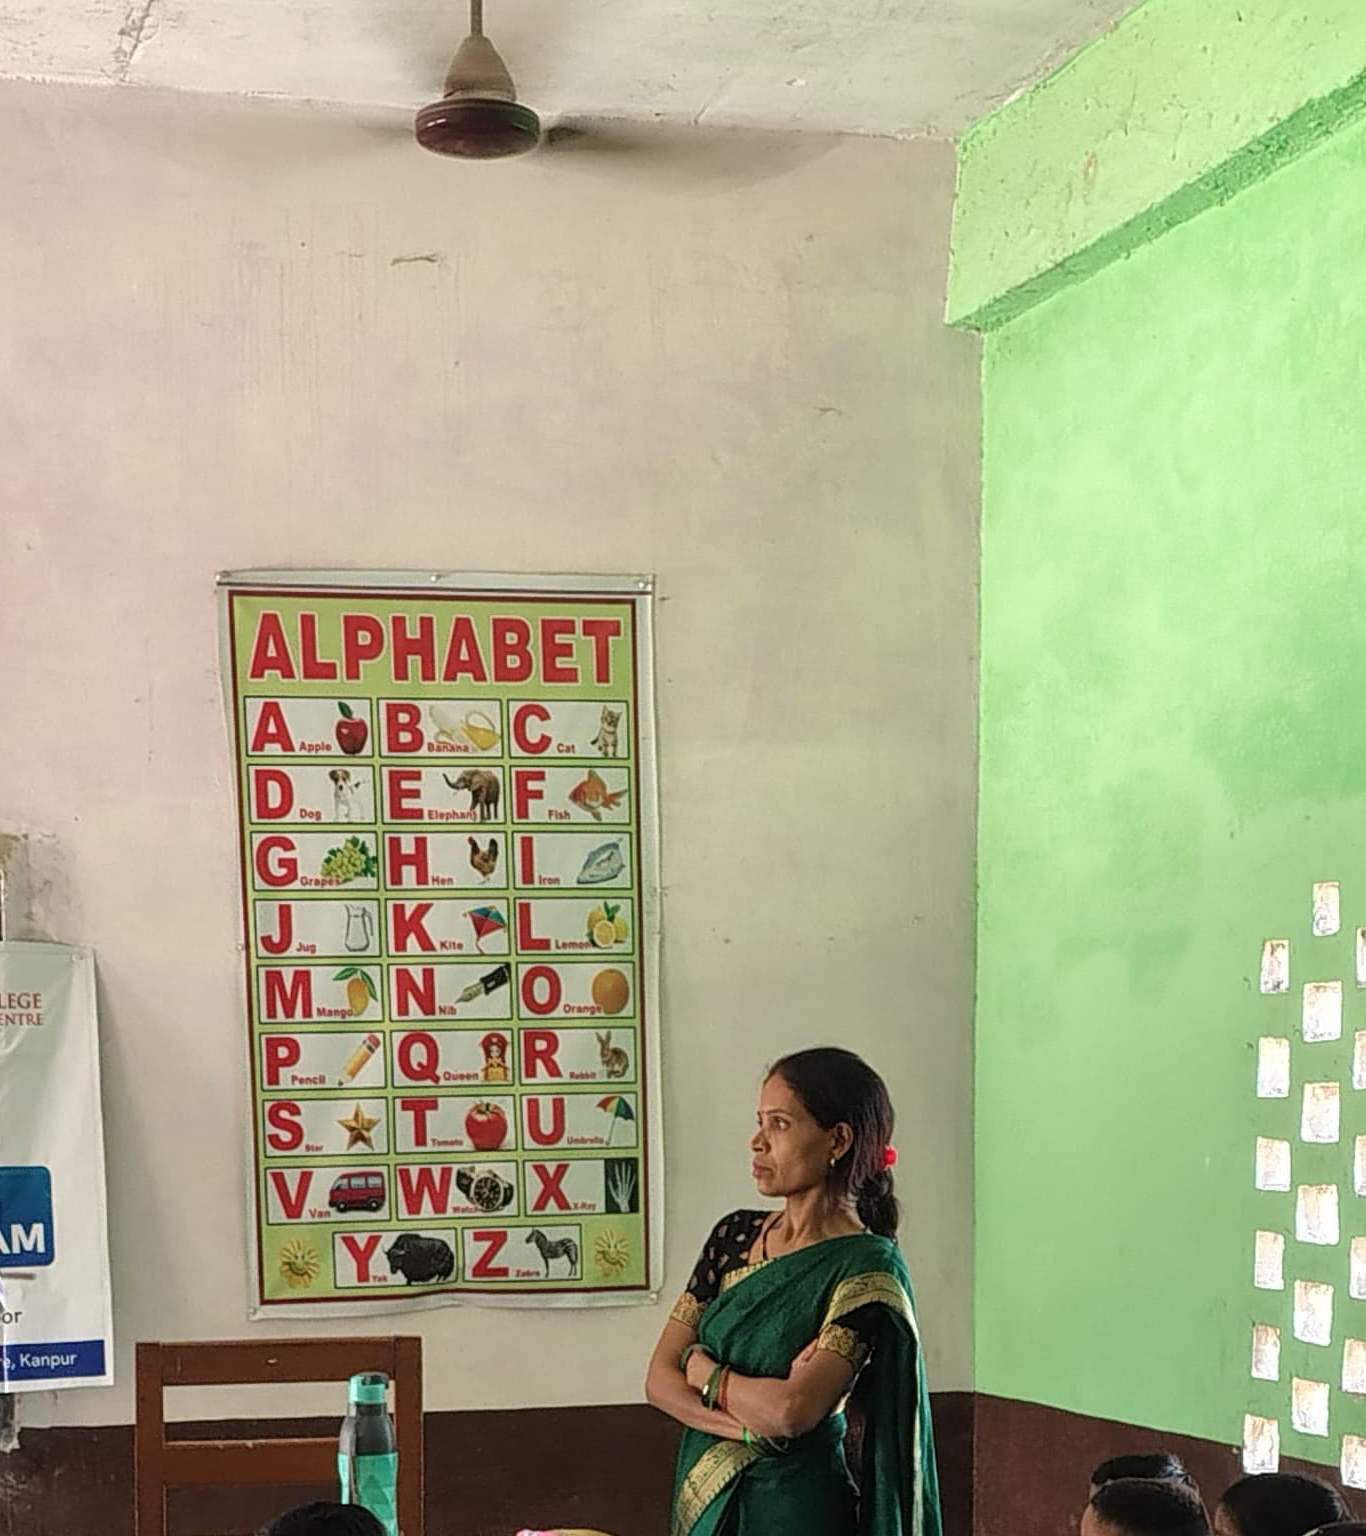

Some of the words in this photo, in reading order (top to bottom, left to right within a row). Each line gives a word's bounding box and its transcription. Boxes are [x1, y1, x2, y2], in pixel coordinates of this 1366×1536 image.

[248, 611, 621, 683] ALPHABET
[250, 701, 295, 753] A
[299, 742, 332, 753] Apple
[385, 703, 424, 753] B
[426, 742, 470, 754] Banana
[513, 703, 552, 754] C
[556, 743, 576, 754] Cat
[254, 769, 293, 820] D
[298, 808, 323, 822] Dog
[388, 770, 424, 819] E
[427, 809, 478, 823] Elephant
[515, 771, 545, 819] F
[547, 809, 572, 822] Fish
[255, 836, 298, 887] G
[388, 836, 429, 885] H
[430, 875, 455, 886] Hen
[520, 836, 534, 885] I
[537, 875, 561, 886] Iron
[260, 904, 291, 954] J
[295, 941, 318, 955] Jug
[392, 903, 436, 952] K
[439, 939, 464, 951] Kite
[518, 903, 550, 951] L
[265, 969, 312, 1019] M
[315, 1005, 354, 1019] Mango
[395, 968, 435, 1016] N
[438, 1004, 458, 1017] Nib
[522, 966, 561, 1015] O
[562, 1002, 603, 1015] Orange
[266, 1035, 301, 1085] P
[290, 1074, 327, 1086] Pencil
[397, 1030, 440, 1084] Q
[442, 1070, 480, 1082] Queen
[523, 1030, 563, 1079] R
[267, 1101, 304, 1151] S
[304, 1142, 325, 1154] Star
[400, 1099, 438, 1147] T
[430, 1137, 465, 1148] Tomato
[527, 1097, 565, 1145] U
[271, 1171, 313, 1219] V
[308, 1207, 332, 1220] Van
[398, 1166, 453, 1216] W
[531, 1163, 571, 1212] X
[340, 1235, 382, 1283] Y
[472, 1231, 509, 1279] Z
[19, 1353, 78, 1371] Kanpur
